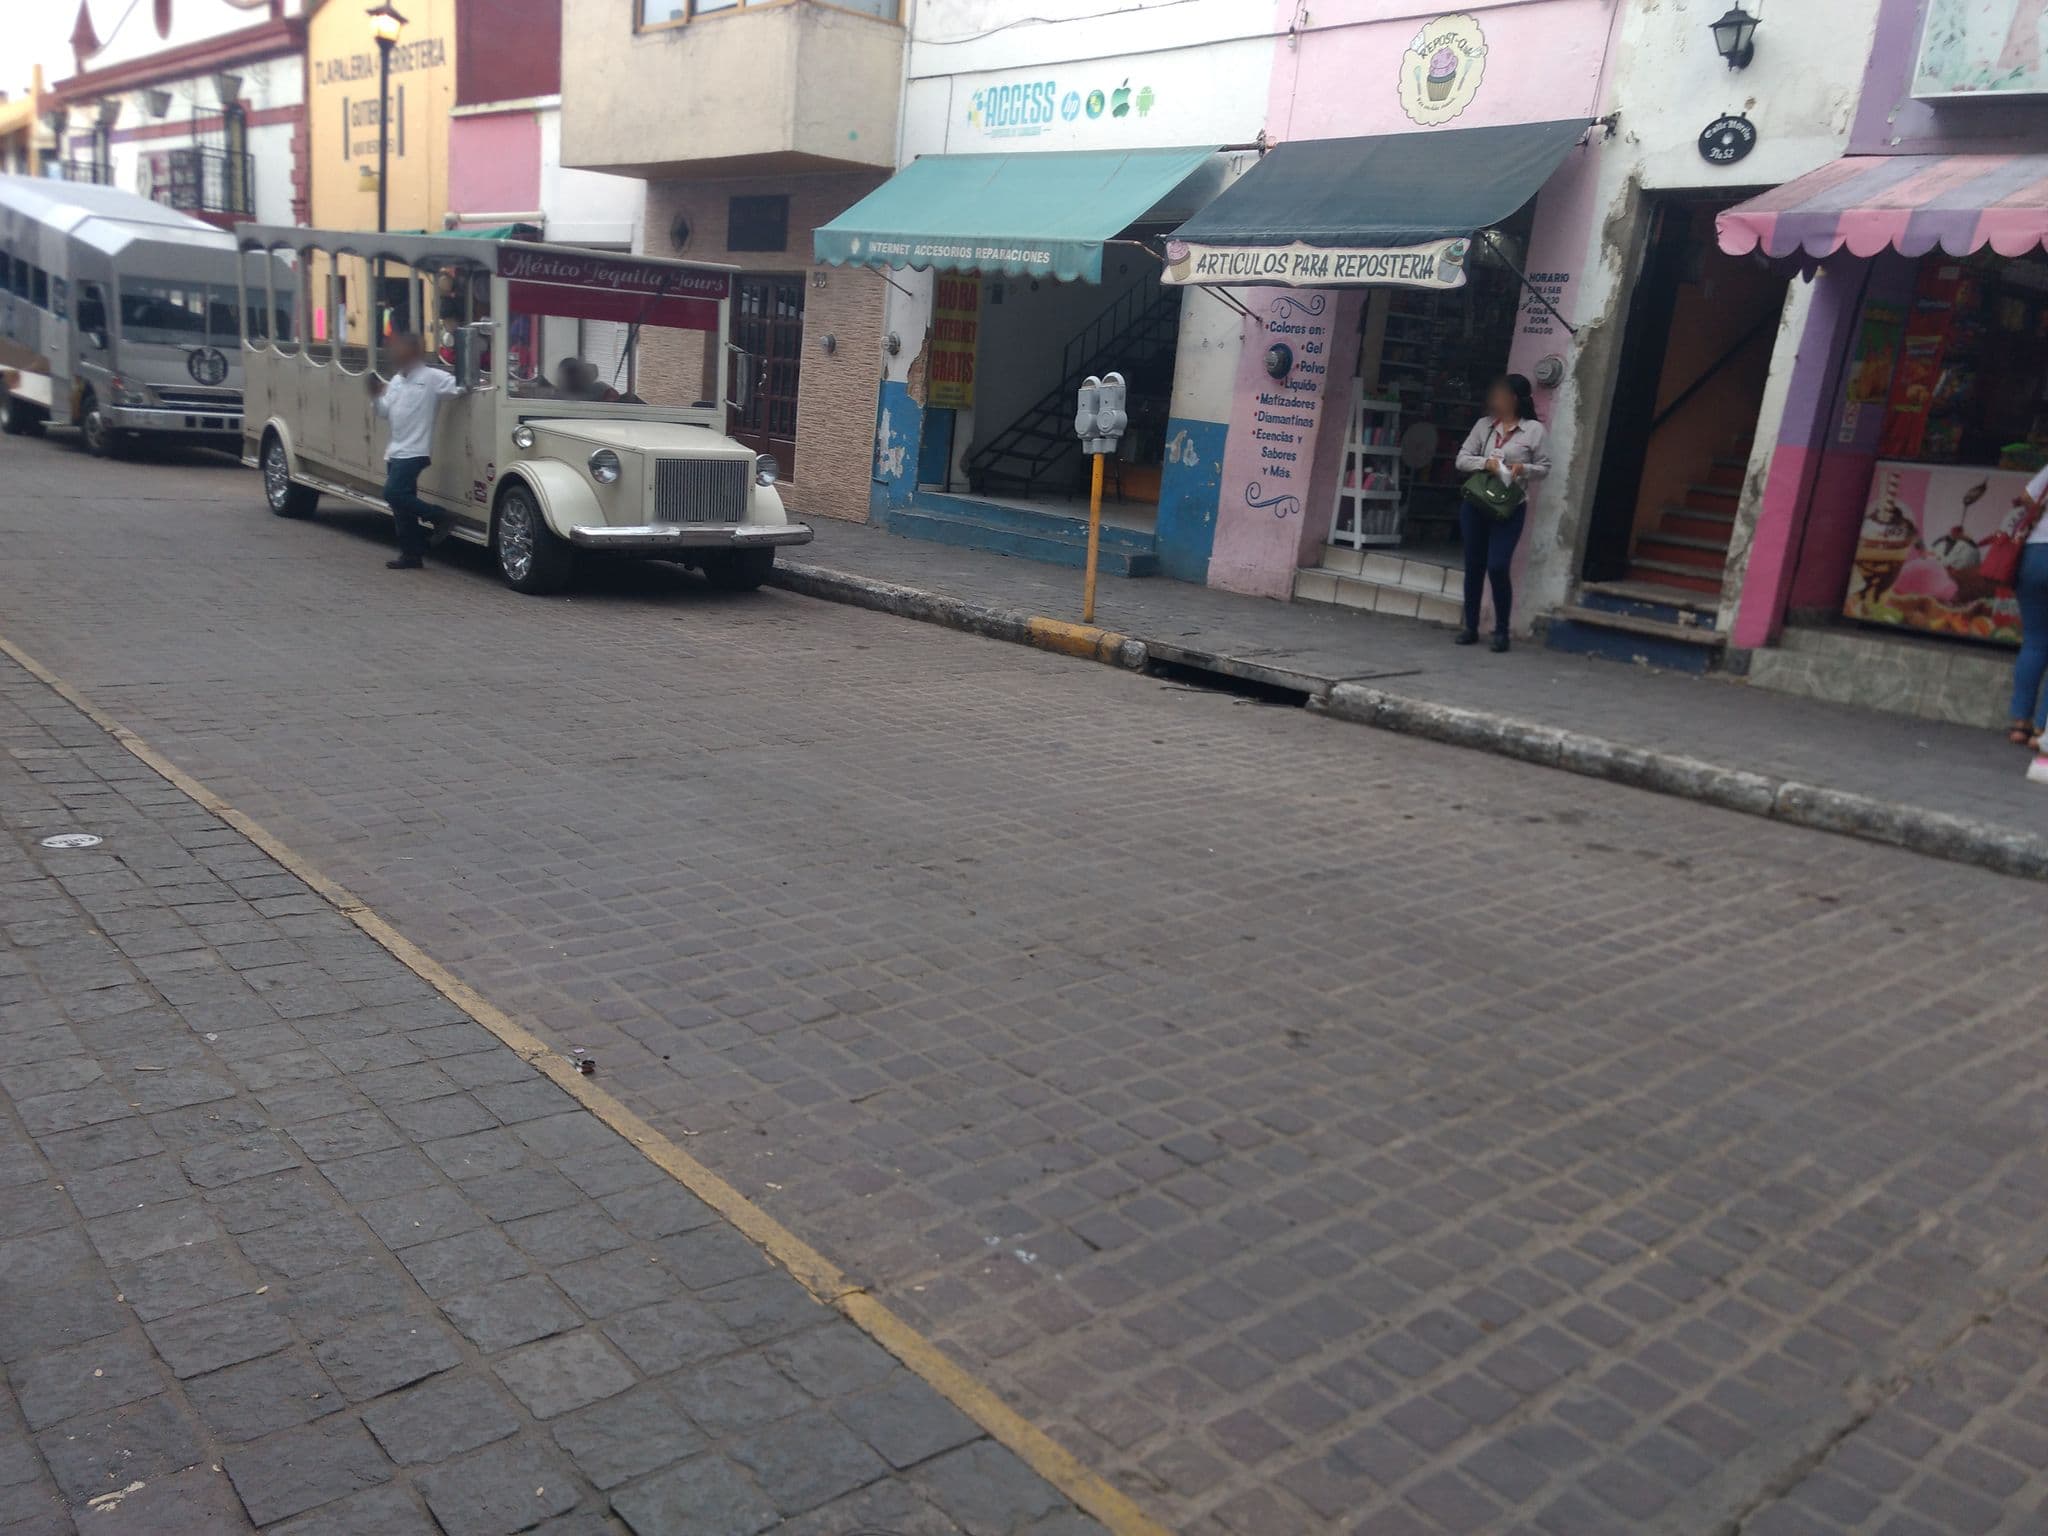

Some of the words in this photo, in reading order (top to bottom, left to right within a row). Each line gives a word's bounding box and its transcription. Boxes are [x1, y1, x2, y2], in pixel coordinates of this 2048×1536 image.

[985, 81, 1056, 127] ACCESS
[868, 241, 911, 256] INTERNET
[914, 244, 973, 259] ACCESORIOS
[975, 247, 1051, 264] REPARACIONES
[504, 251, 581, 278] México
[582, 259, 664, 288] Tequila
[669, 270, 725, 293] Tours
[1195, 252, 1289, 275] ARTICULOS
[1292, 252, 1329, 278] PARA
[1333, 253, 1435, 280] REPOSTERIA
[1528, 272, 1570, 282] HORARIO
[1269, 321, 1306, 335] Colores
[1305, 341, 1324, 354] Gel
[932, 350, 974, 385] GRATIS
[1299, 360, 1326, 375] Polvo
[1260, 392, 1317, 410] Matizadores
[1257, 410, 1315, 428] Diamantinas
[1255, 428, 1294, 443] Ecencias
[1261, 446, 1297, 461] Sabores
